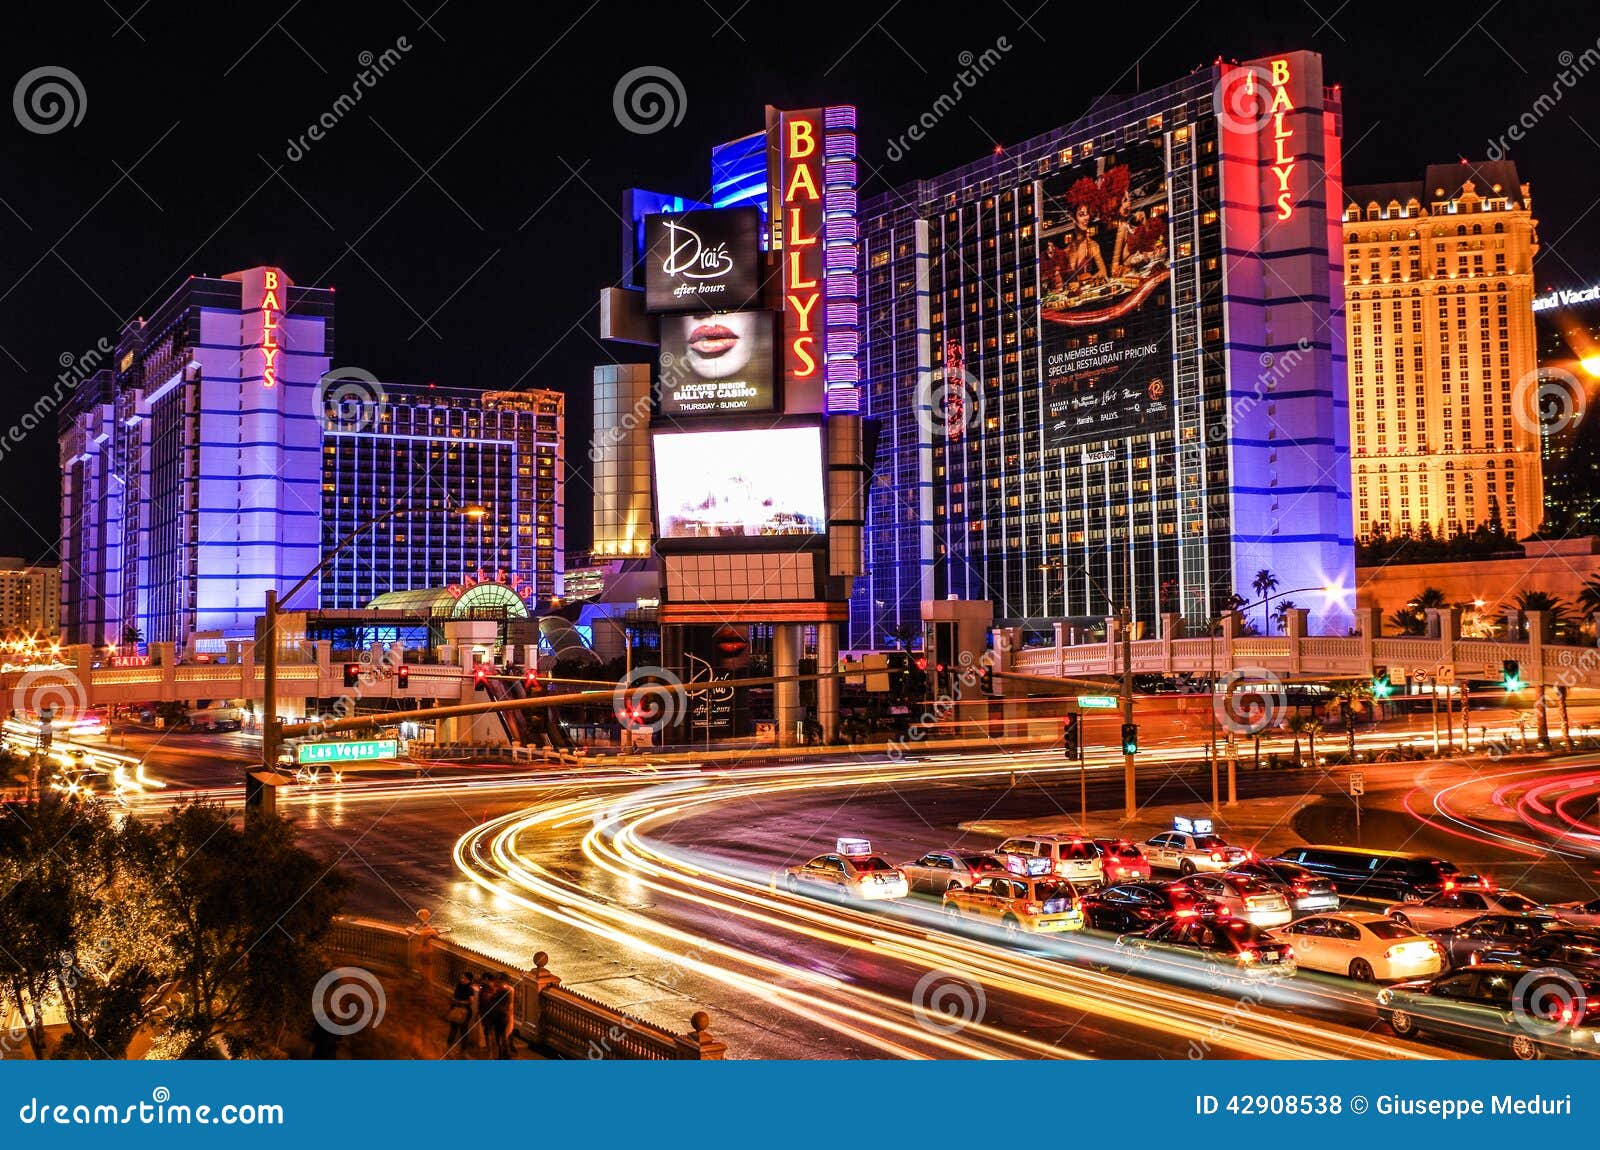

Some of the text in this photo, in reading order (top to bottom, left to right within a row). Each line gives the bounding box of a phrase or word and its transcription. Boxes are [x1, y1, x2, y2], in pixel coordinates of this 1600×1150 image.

[1270, 59, 1297, 221] BALLYS
[662, 219, 734, 279] Drai's
[785, 119, 819, 377] BALLYS
[673, 281, 726, 298] after hours
[1532, 291, 1559, 312] and
[261, 270, 281, 389] BALLYS
[1048, 341, 1115, 365] OUR MEMBERS GET
[1048, 363, 1076, 377] SPECIAL
[1077, 351, 1124, 370] RESTAURANT
[673, 387, 757, 400] BALLY'S CASINO
[681, 381, 747, 392] LOCATED INSIDE
[679, 402, 716, 411] THURSDAY
[720, 400, 748, 409] SUNDAY
[309, 746, 332, 759] Las
[335, 743, 374, 760] Vegas
